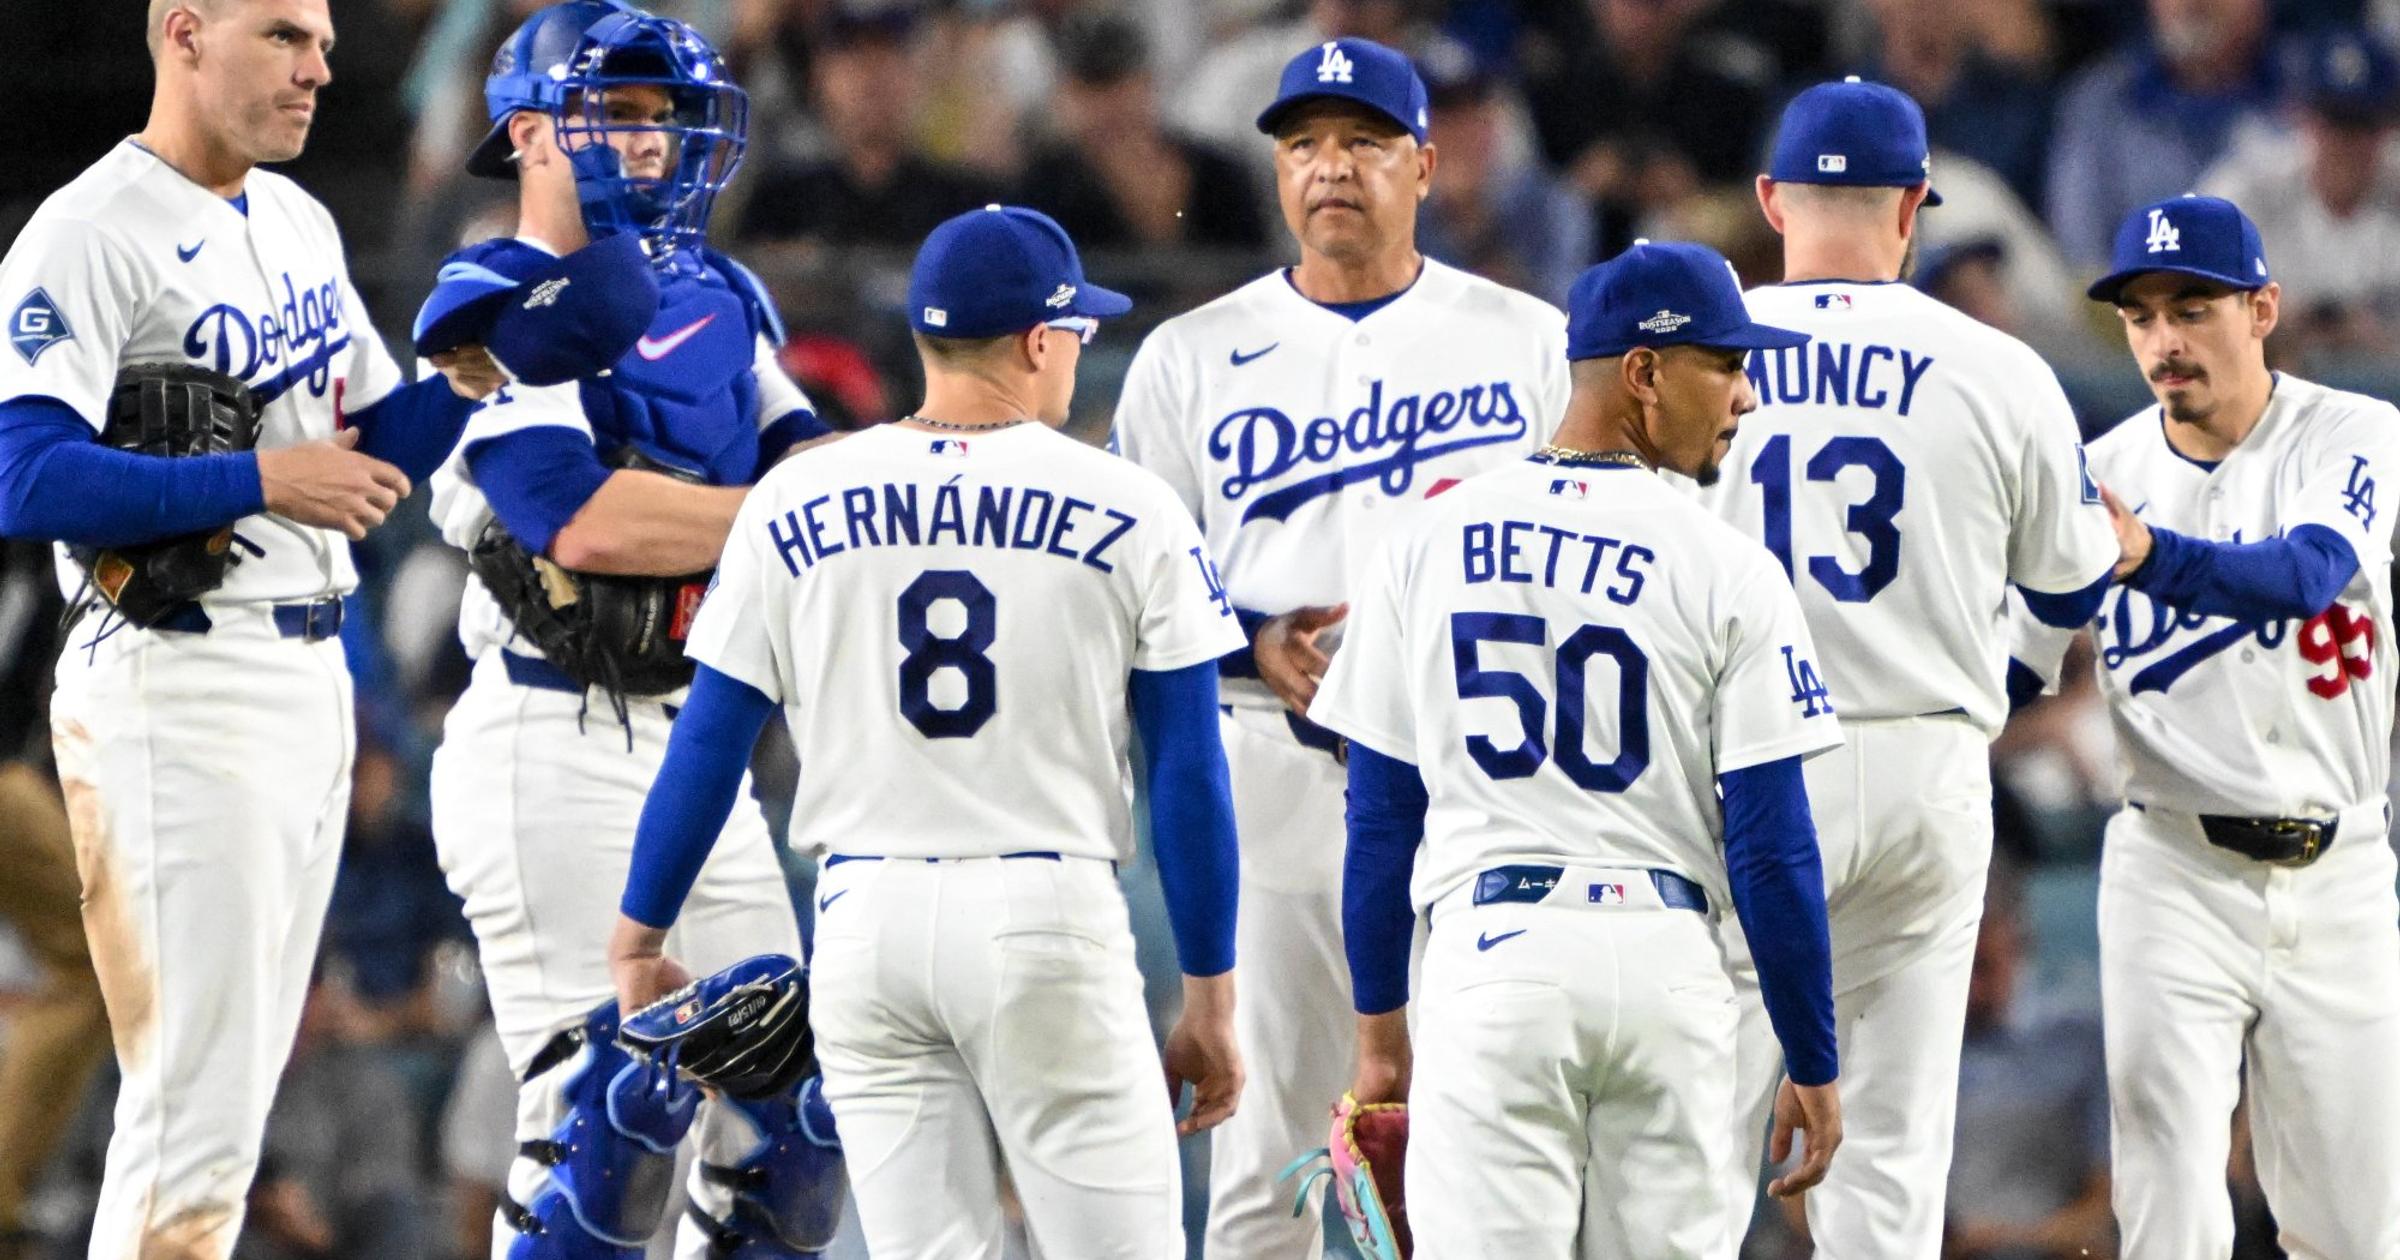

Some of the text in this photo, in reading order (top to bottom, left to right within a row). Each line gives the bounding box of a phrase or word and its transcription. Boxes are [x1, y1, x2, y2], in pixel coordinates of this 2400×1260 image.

[1317, 41, 1353, 82] LA
[2146, 209, 2181, 253] LA
[183, 271, 349, 398] Dodge
[1207, 379, 1528, 501] Dodgers
[767, 474, 1137, 579] HERNÁNDEZ
[1750, 434, 1906, 604] 13
[2340, 454, 2377, 534] LA
[1462, 520, 1656, 607] BETTS
[897, 569, 997, 739] 8
[1450, 611, 1650, 793] 50
[1780, 645, 1834, 719] LA
